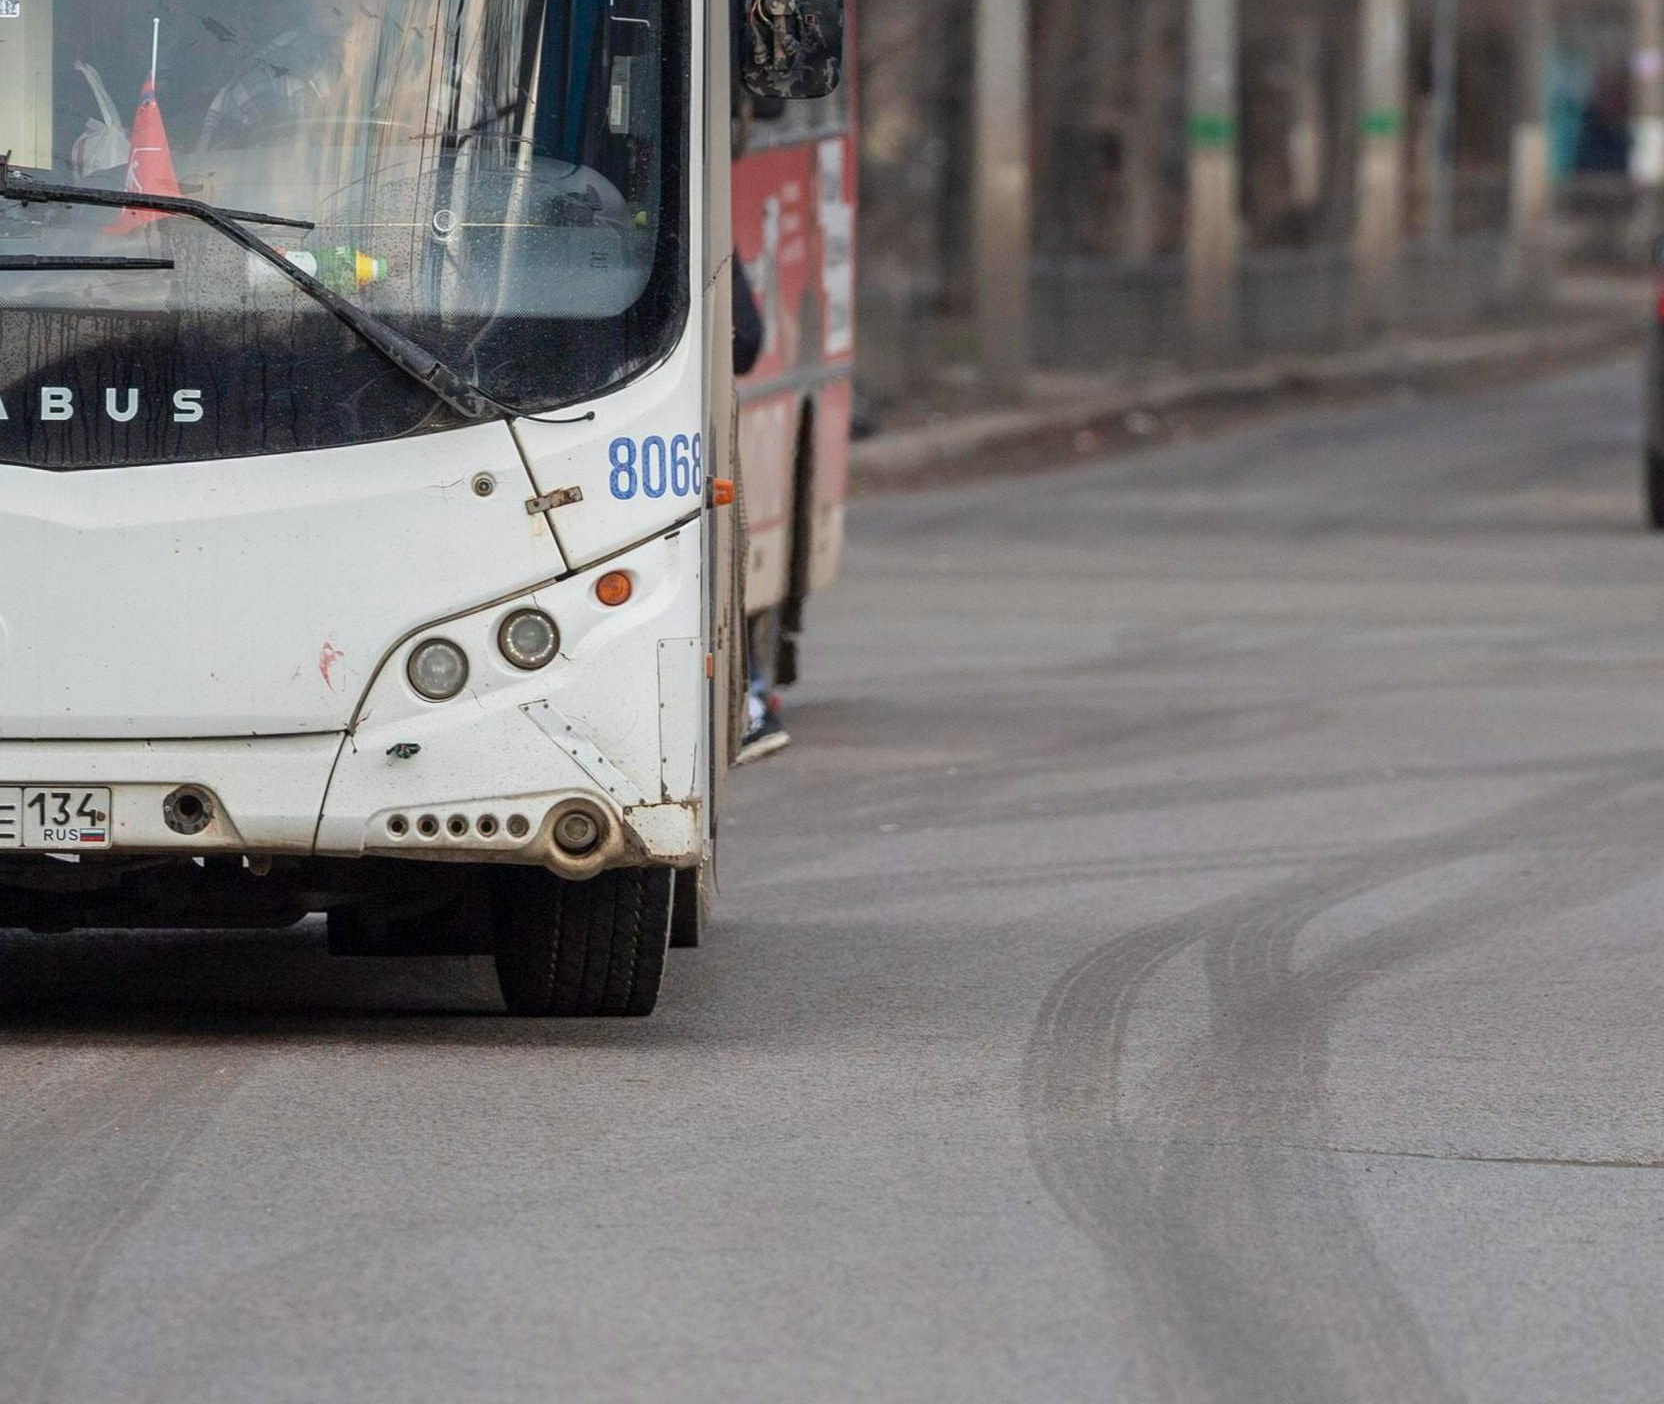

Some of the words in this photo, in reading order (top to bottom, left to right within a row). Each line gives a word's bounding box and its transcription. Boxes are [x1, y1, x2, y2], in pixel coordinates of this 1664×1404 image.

[609, 433, 702, 501] 8068
[28, 792, 99, 827] 134
[43, 828, 78, 841] RUS
